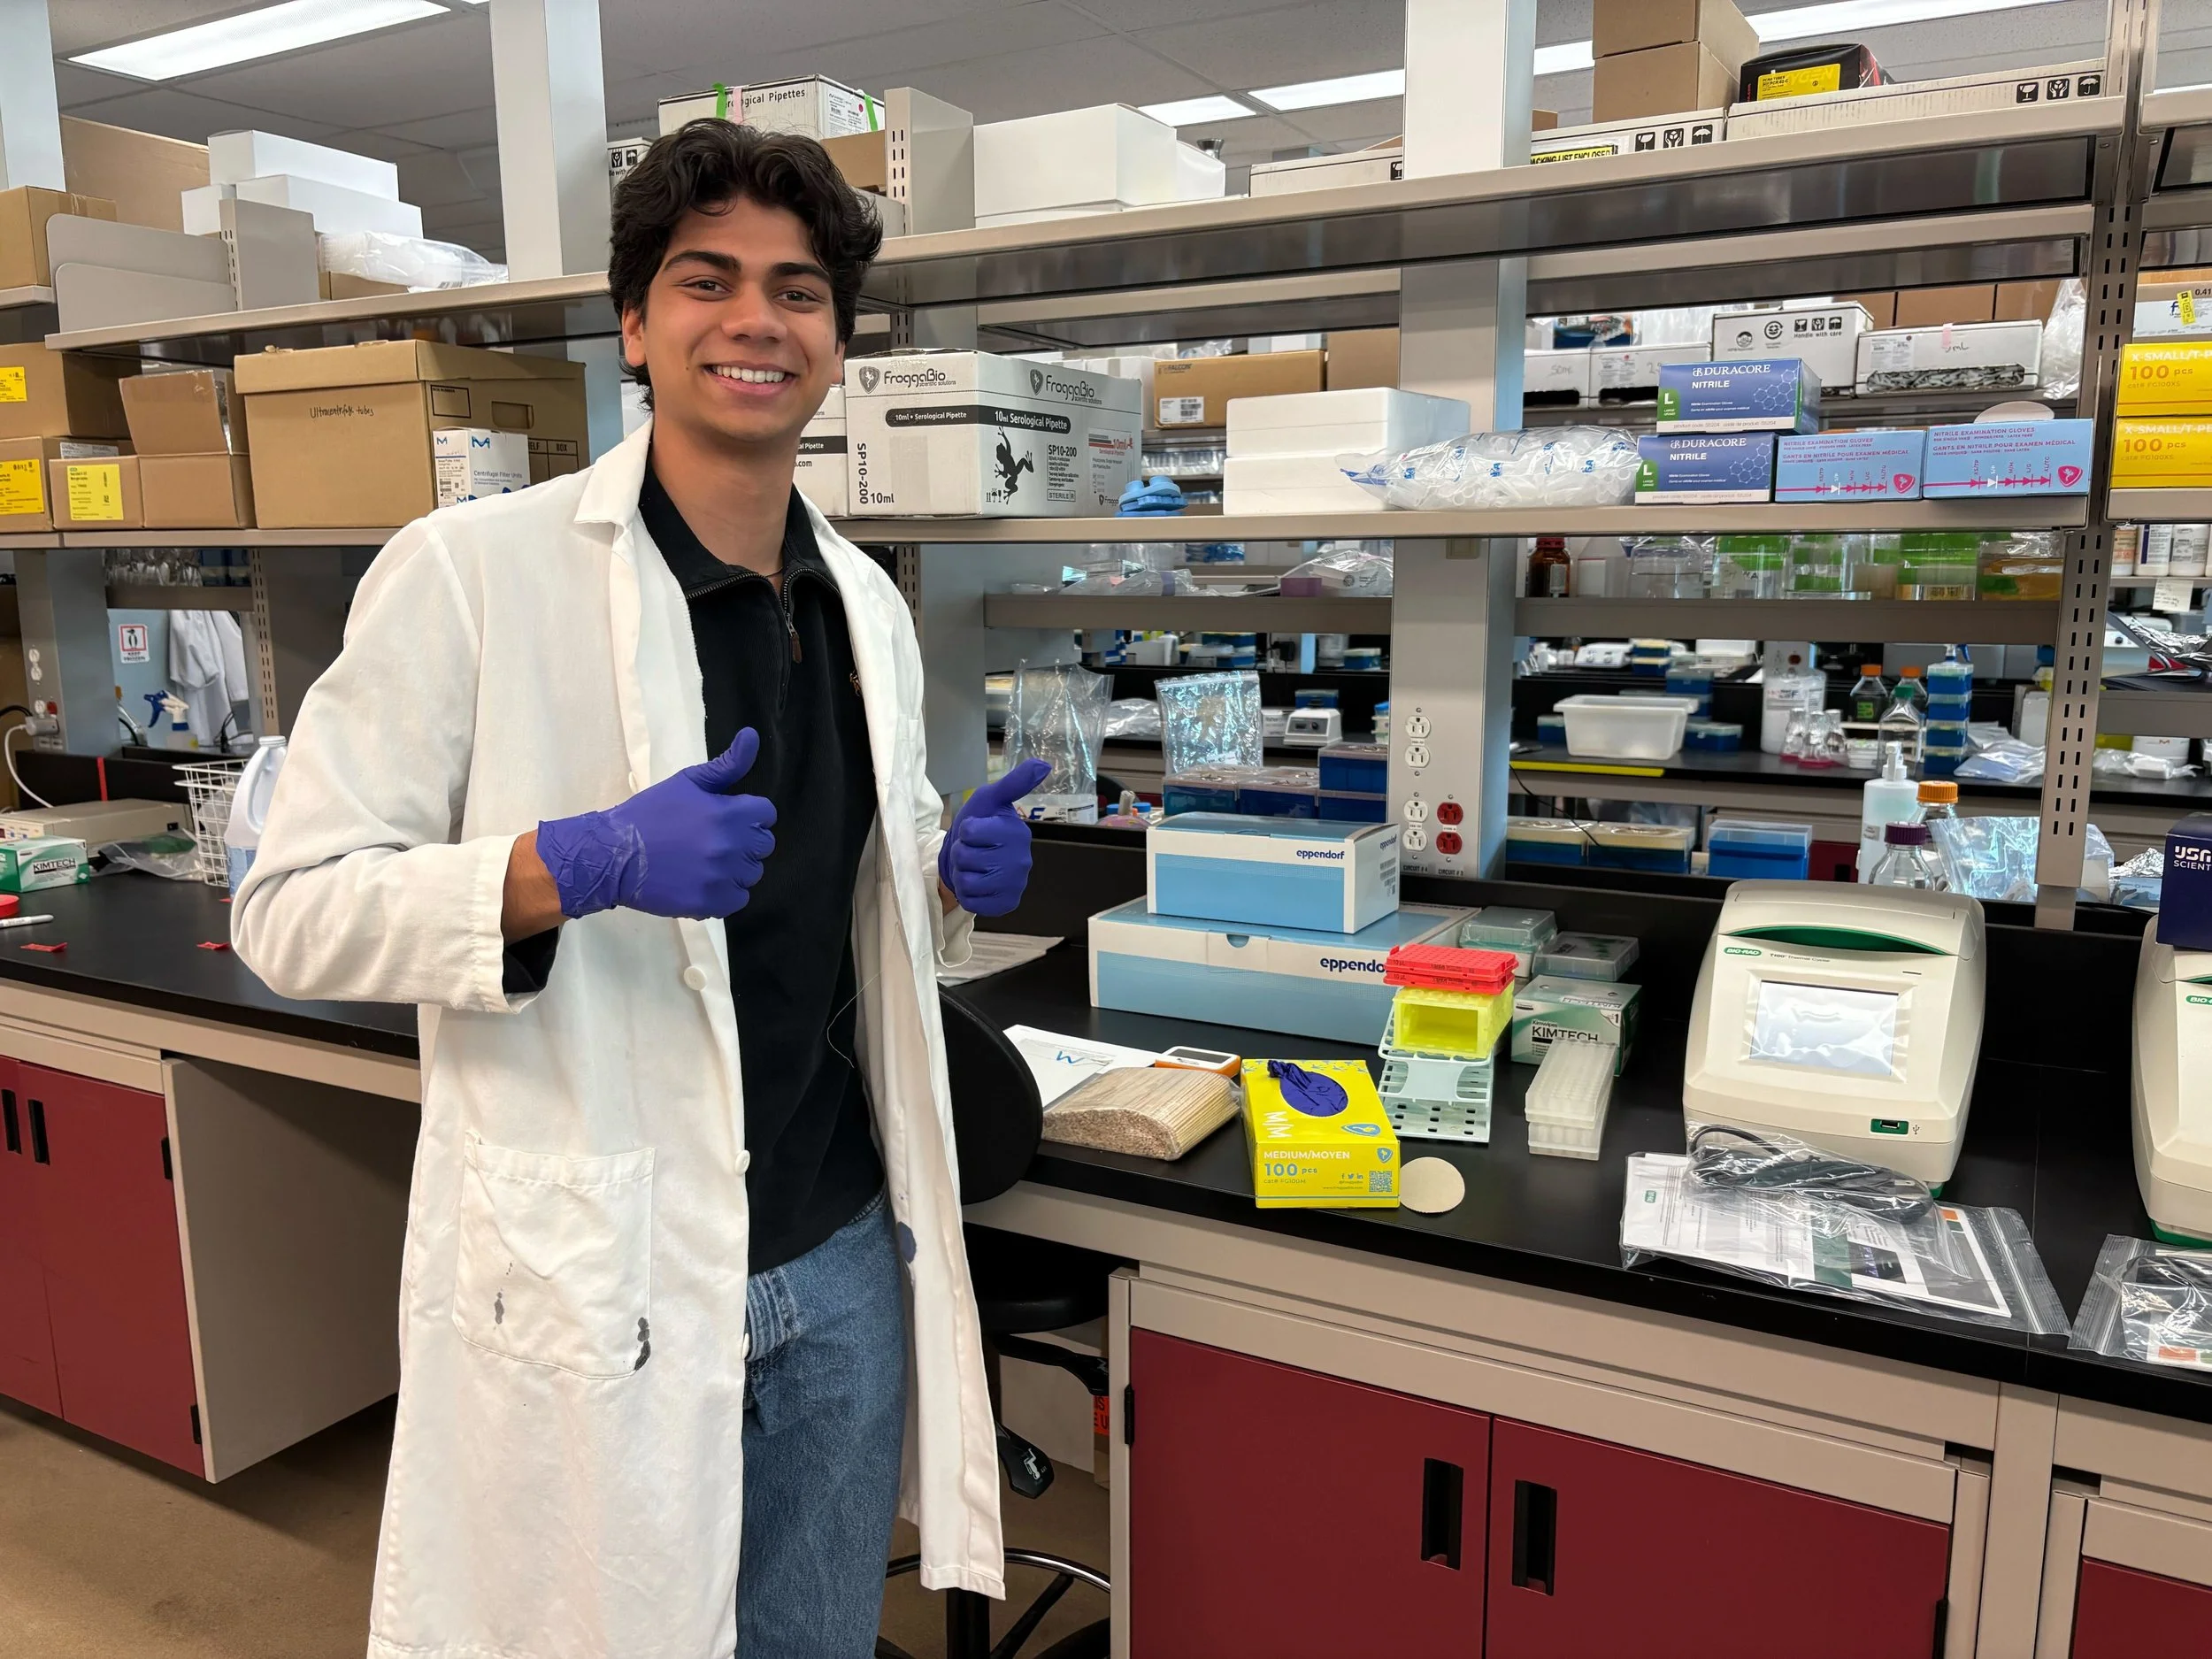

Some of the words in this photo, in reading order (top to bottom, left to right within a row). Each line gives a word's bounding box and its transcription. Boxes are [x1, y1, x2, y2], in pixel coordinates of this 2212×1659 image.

[768, 88, 805, 103] Pipettes
[1558, 153, 1573, 162] LIST
[1704, 365, 1770, 376] DURACORE
[2130, 365, 2170, 380] 100
[884, 368, 946, 388] FroggaBio
[1692, 380, 1731, 389] NITRILE
[1046, 374, 1094, 401] FroggaBio
[1663, 392, 1674, 405] L
[356, 404, 374, 417] tubes
[914, 411, 946, 422] Serological
[946, 411, 967, 420] Pipette
[995, 411, 1009, 423] 10ml
[1010, 412, 1045, 428] Serological
[1045, 417, 1068, 431] Pipette
[1681, 437, 1747, 449] DURACORE
[2124, 438, 2162, 452] 100
[1048, 444, 1077, 457] SP10-200
[1670, 452, 1707, 461] NITRILE
[473, 470, 499, 479] Centrifugal
[856, 442, 869, 504] SP10-200
[1643, 464, 1653, 476] L
[870, 492, 895, 503] 10ml
[1296, 849, 1345, 860] eppendorf
[33, 857, 77, 871] KIMTECH
[1726, 947, 1760, 956] BIO-RAD
[1319, 957, 1386, 972] eppendo
[1532, 1019, 1558, 1028] Kimwipes
[1532, 1025, 1599, 1041] KIMTECH
[1263, 1110, 1294, 1139] M/M
[1263, 1149, 1351, 1160] MEDIUM/MOYEN
[1264, 1163, 1298, 1177] 100
